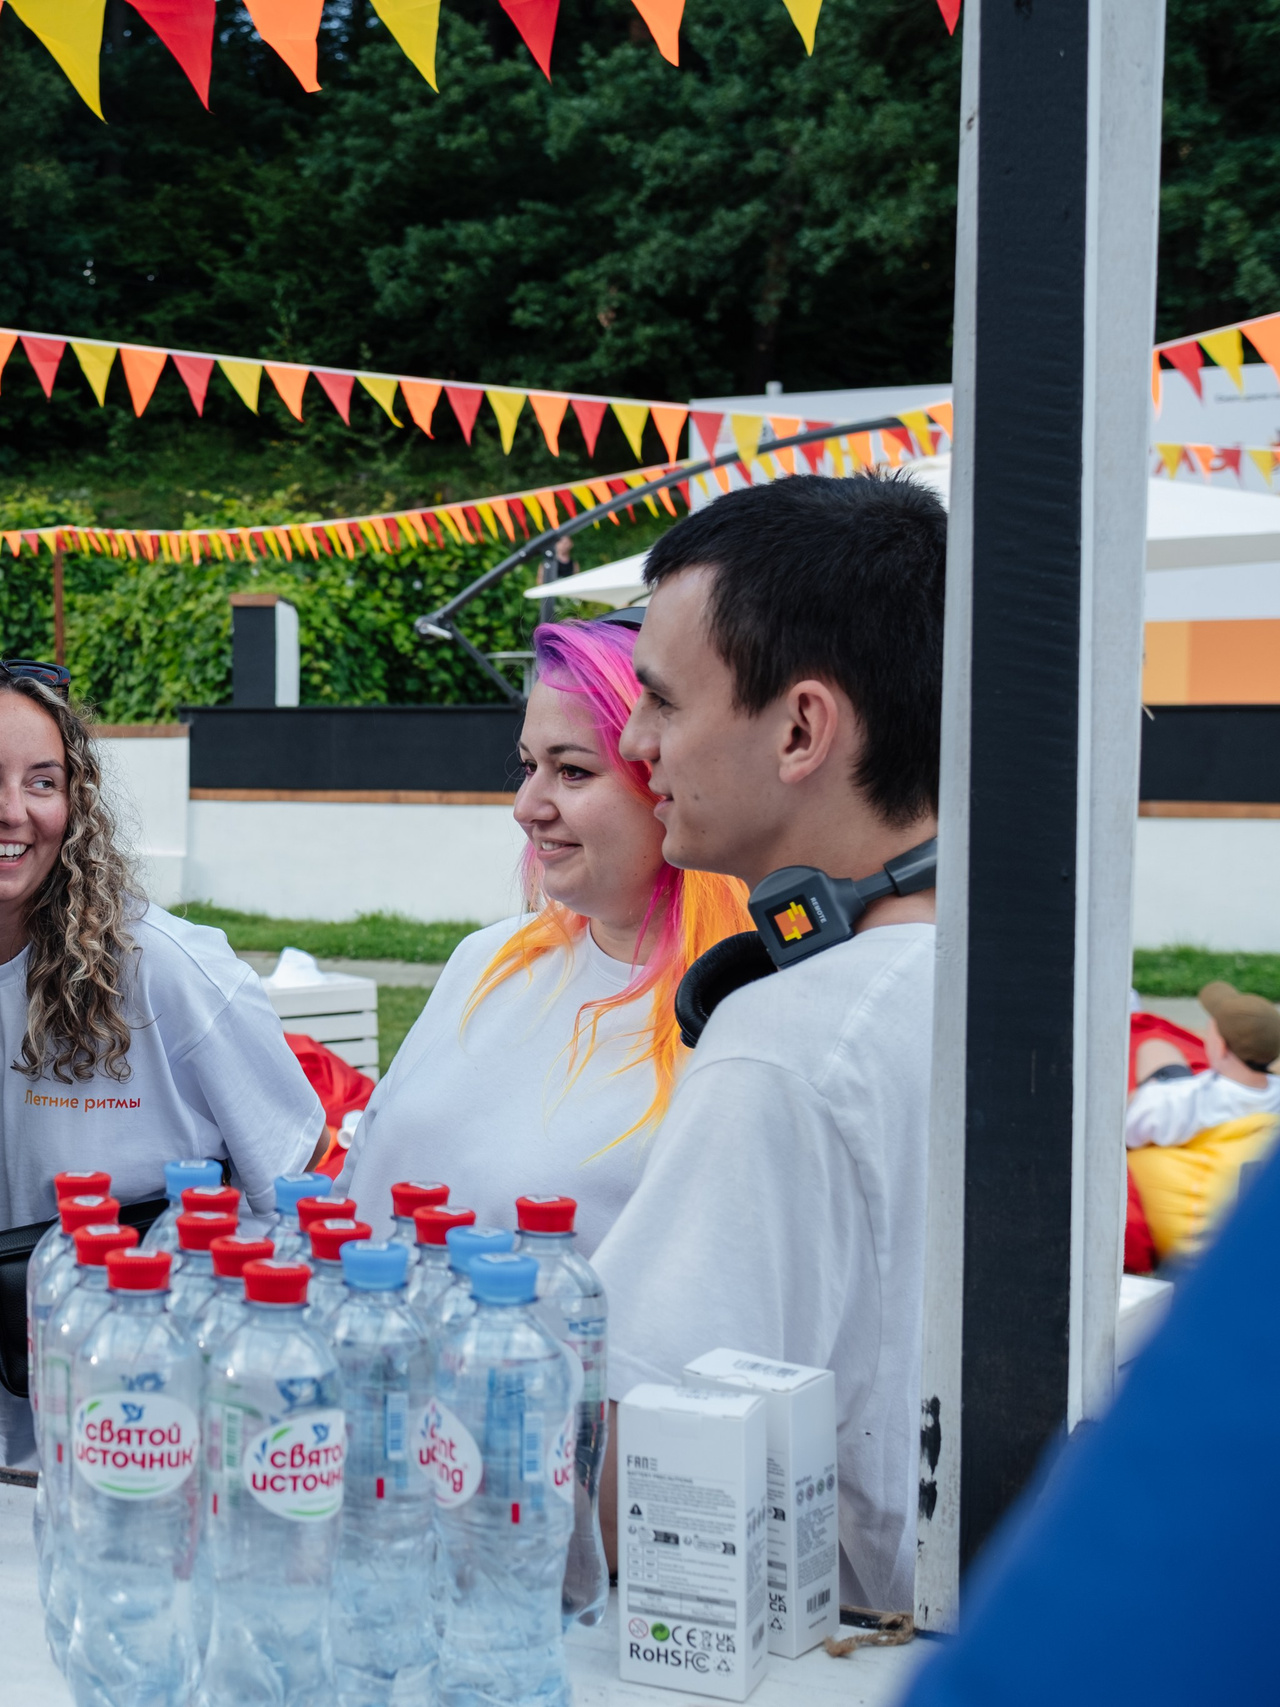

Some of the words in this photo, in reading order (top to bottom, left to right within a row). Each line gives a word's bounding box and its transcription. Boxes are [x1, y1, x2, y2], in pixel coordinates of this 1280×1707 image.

[810, 896, 828, 924] REMOTE
[24, 1089, 79, 1108] Летние
[84, 1098, 141, 1113] ритмы
[629, 1642, 682, 1668] RoHS
